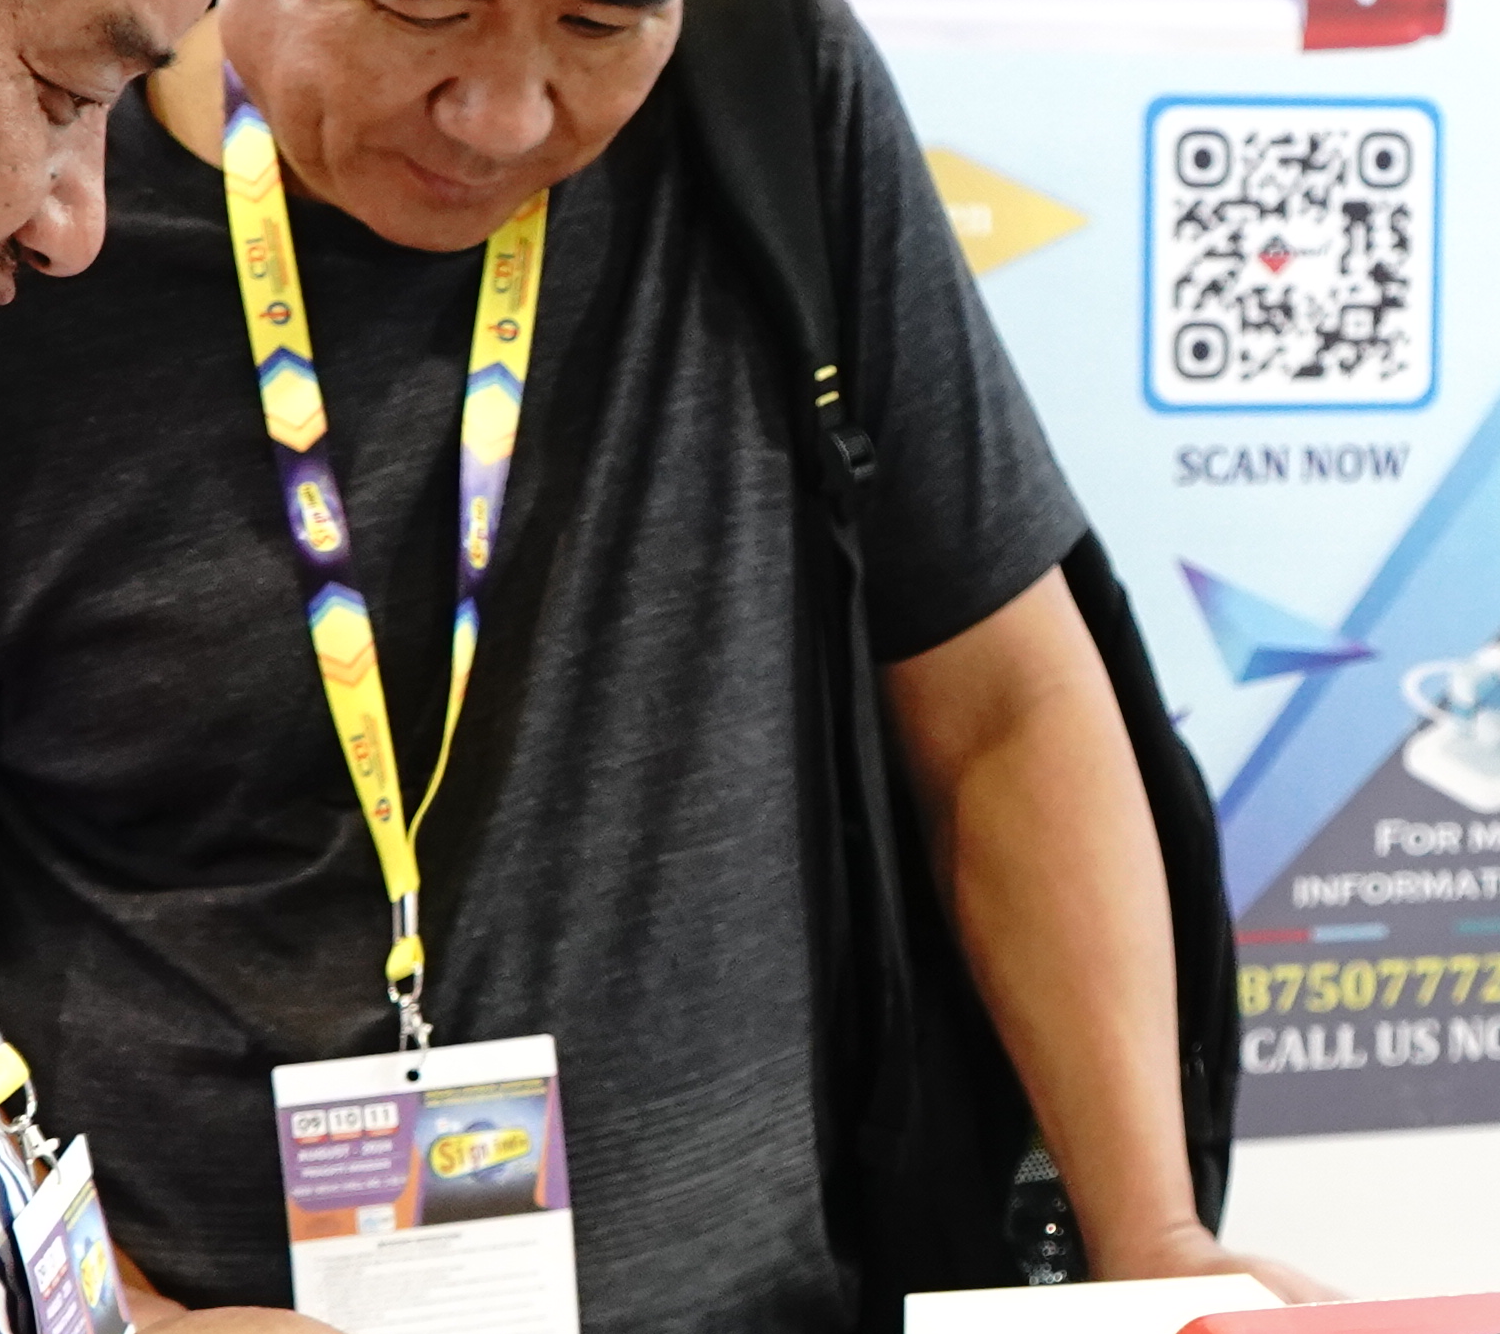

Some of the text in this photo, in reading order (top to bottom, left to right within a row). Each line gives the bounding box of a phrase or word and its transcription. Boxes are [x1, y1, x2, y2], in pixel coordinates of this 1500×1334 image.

[1173, 442, 1411, 486] SCAN NOW
[1376, 819, 1463, 857] FOR
[1241, 1024, 1368, 1074] CALL
[1376, 1019, 1440, 1066] US
